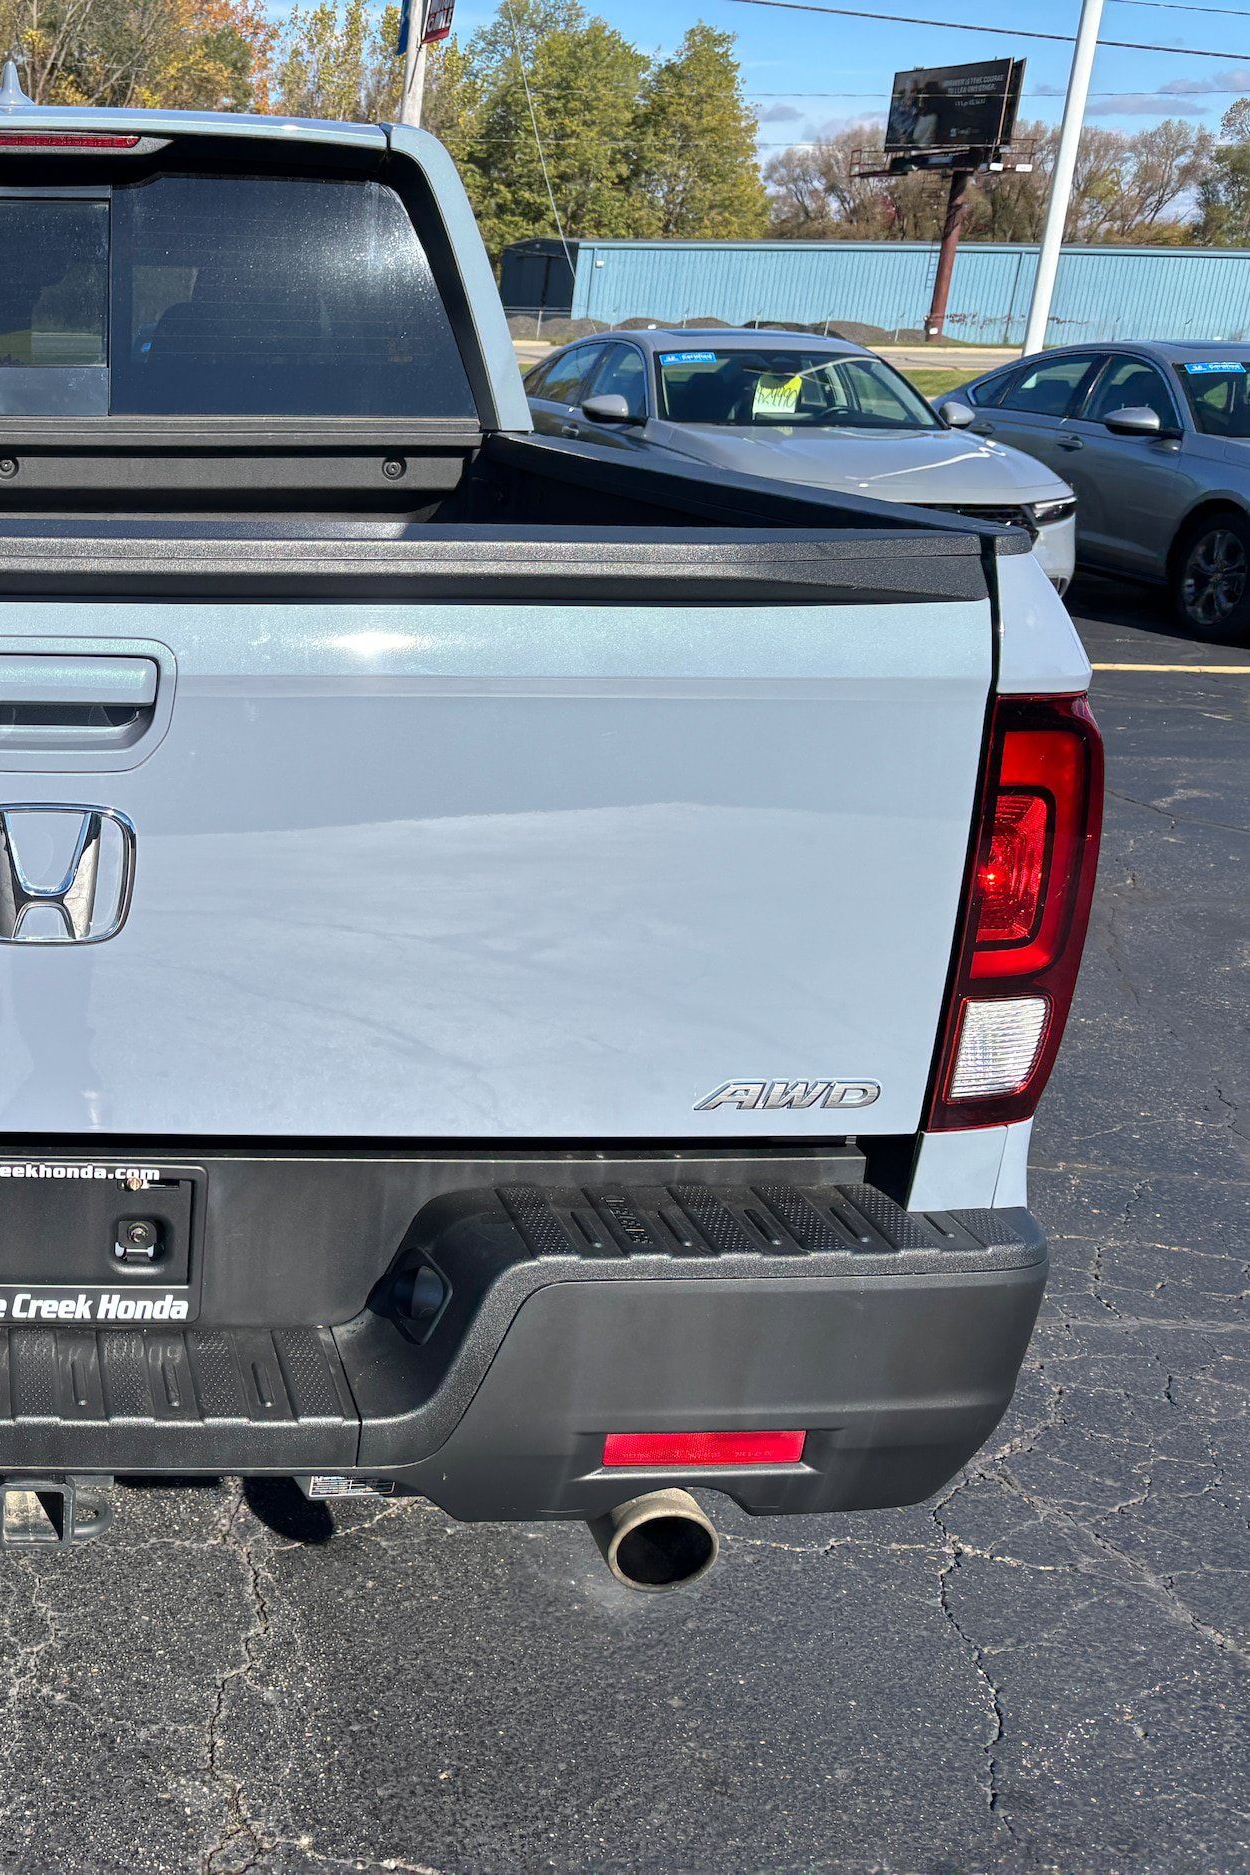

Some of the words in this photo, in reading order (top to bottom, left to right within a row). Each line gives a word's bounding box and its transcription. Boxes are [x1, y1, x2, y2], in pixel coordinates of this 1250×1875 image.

[693, 1078, 882, 1110] AWD
[12, 1293, 93, 1319] Creek
[96, 1294, 189, 1320] Honda
